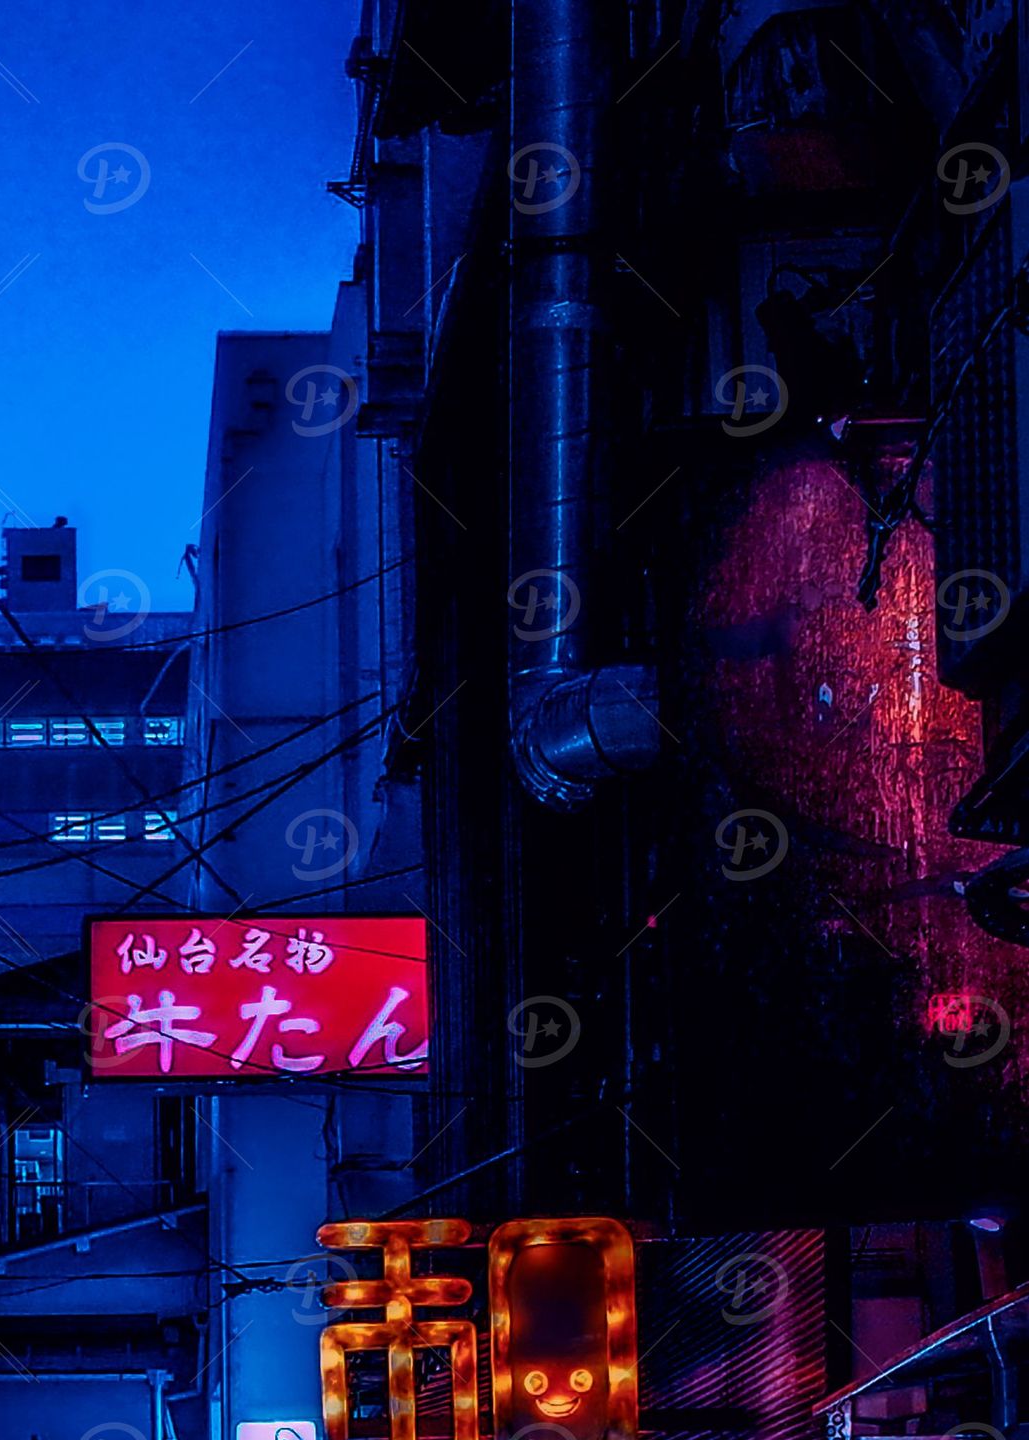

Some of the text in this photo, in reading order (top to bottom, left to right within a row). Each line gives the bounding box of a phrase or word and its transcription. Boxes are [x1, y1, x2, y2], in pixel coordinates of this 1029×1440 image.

[117, 927, 334, 974] 仙台名物
[104, 985, 428, 1072] 牛たん
